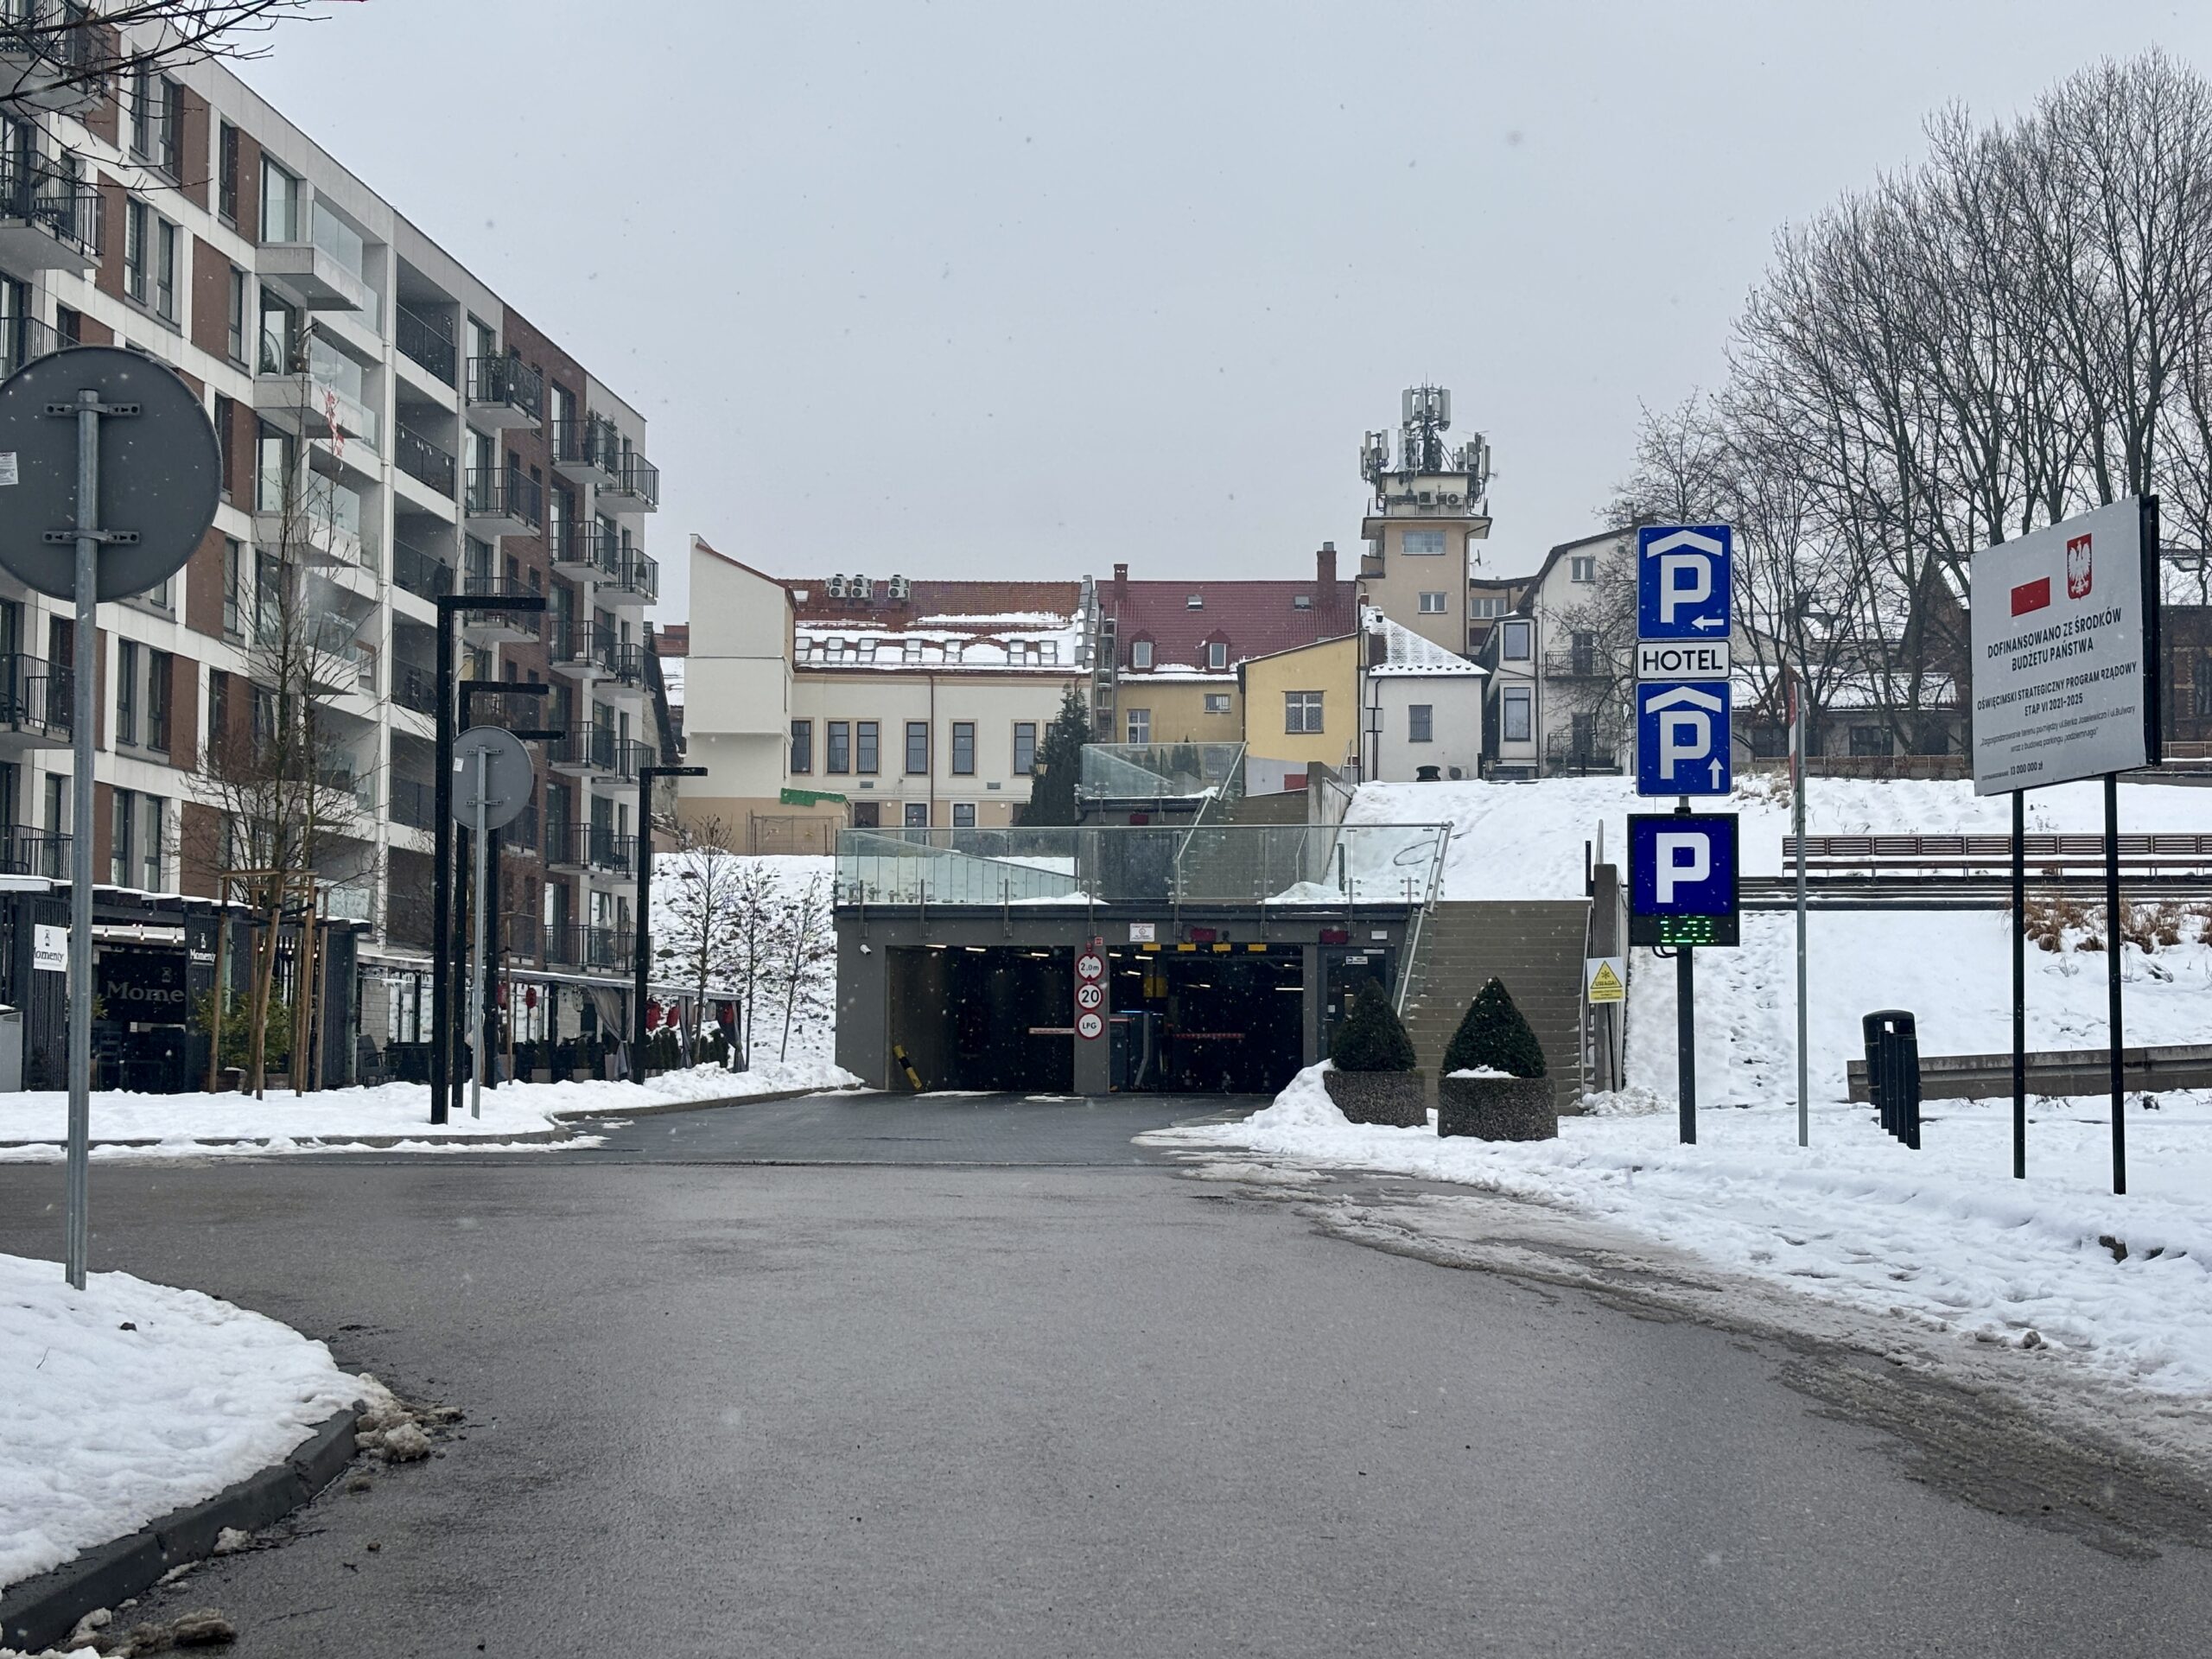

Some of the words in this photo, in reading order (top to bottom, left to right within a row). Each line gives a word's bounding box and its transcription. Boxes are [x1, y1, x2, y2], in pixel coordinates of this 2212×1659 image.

[1660, 554, 1713, 624] P
[1987, 625, 2062, 658] DOFINANSOWANO
[2063, 621, 2073, 638] ZE
[2075, 607, 2121, 634] ŚRODKÓW
[1643, 650, 1723, 671] HOTEL
[2012, 649, 2049, 671] BUDŻETU
[2050, 637, 2094, 661] PAŃSTWA
[1977, 691, 2017, 711] OŚWIĘCIMSKI
[2018, 679, 2065, 701] STRATEGICZNY
[2066, 671, 2100, 689] PROGRAM
[2101, 661, 2137, 681] RZĄDOWY
[2024, 702, 2040, 716] ETAP
[2041, 701, 2049, 713] VI
[2049, 693, 2083, 711] 2021-2025
[1659, 710, 1712, 780] P
[2016, 763, 2026, 774] 000
[2027, 761, 2037, 772] 000
[1656, 831, 1711, 903] P
[34, 947, 64, 963] omenty
[1081, 989, 1099, 1003] 20
